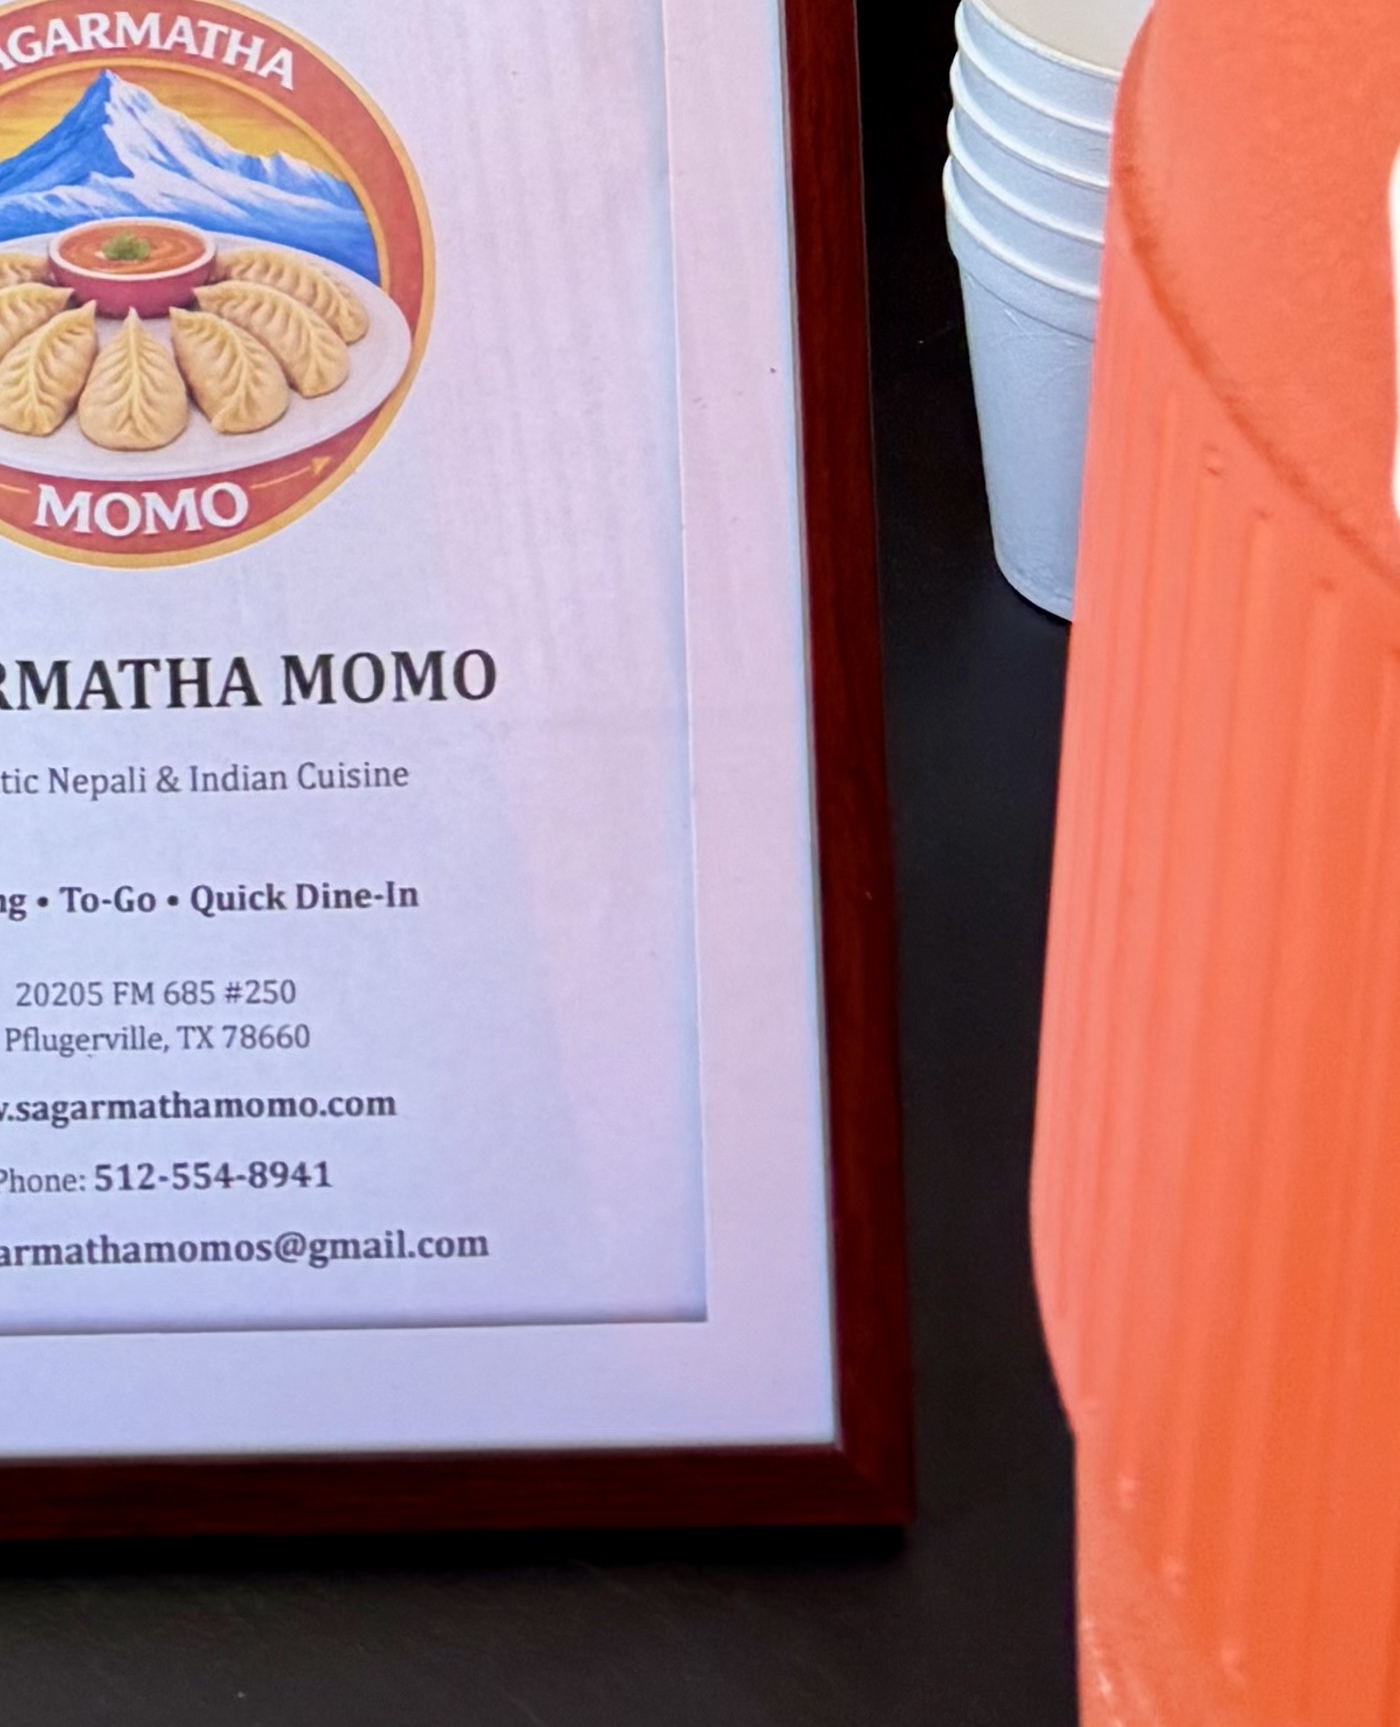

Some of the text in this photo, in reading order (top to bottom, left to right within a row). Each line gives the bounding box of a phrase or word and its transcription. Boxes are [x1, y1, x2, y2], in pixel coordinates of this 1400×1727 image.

[34, 481, 249, 539] MOMO
[280, 648, 497, 706] MOMO
[47, 765, 147, 802] Nepali
[155, 765, 182, 794] &
[189, 763, 288, 793] Indian
[297, 761, 410, 791] Cuisine
[58, 885, 157, 914] To-Go
[190, 882, 288, 918] Quick
[295, 880, 420, 910] Dine-In
[15, 979, 297, 1007] 20205 FM 685 #250
[4, 1023, 311, 1056] Pflugerville, TX 78660
[94, 1160, 332, 1192] 512-554-8941
